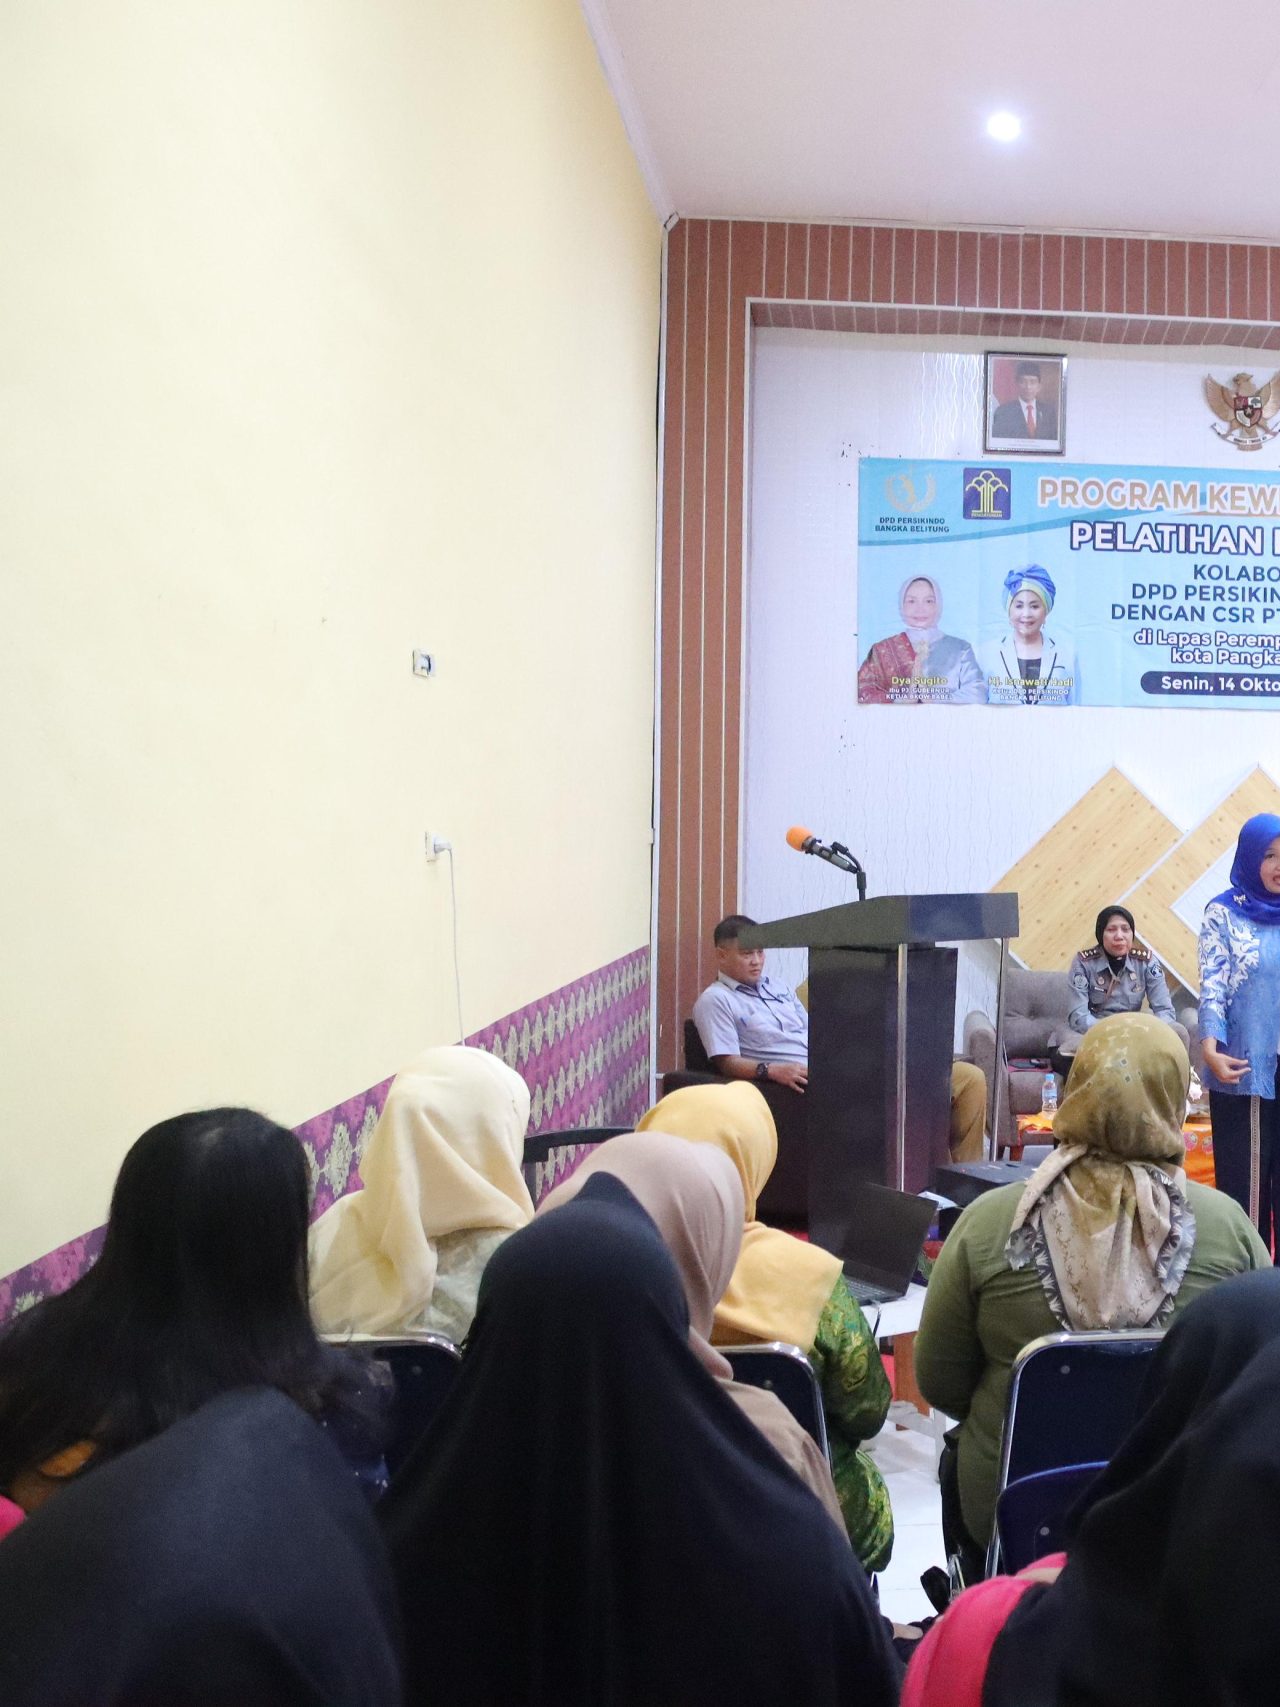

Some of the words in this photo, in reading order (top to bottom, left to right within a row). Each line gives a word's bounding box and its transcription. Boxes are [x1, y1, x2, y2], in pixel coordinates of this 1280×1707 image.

[1038, 479, 1198, 511] PROGRAM
[910, 525, 950, 533] BELITUNG
[1070, 521, 1264, 556] PELATIHAN
[1132, 584, 1177, 601] DPD
[1111, 604, 1206, 622] DENGAN
[1212, 606, 1255, 624] CSR
[1133, 628, 1153, 645] di
[1156, 630, 1211, 648] Lapas
[1171, 647, 1213, 664] kota
[891, 676, 911, 686] Dya
[914, 676, 948, 686] Sugito
[1161, 676, 1214, 692] Senin,
[1218, 677, 1235, 691] 14
